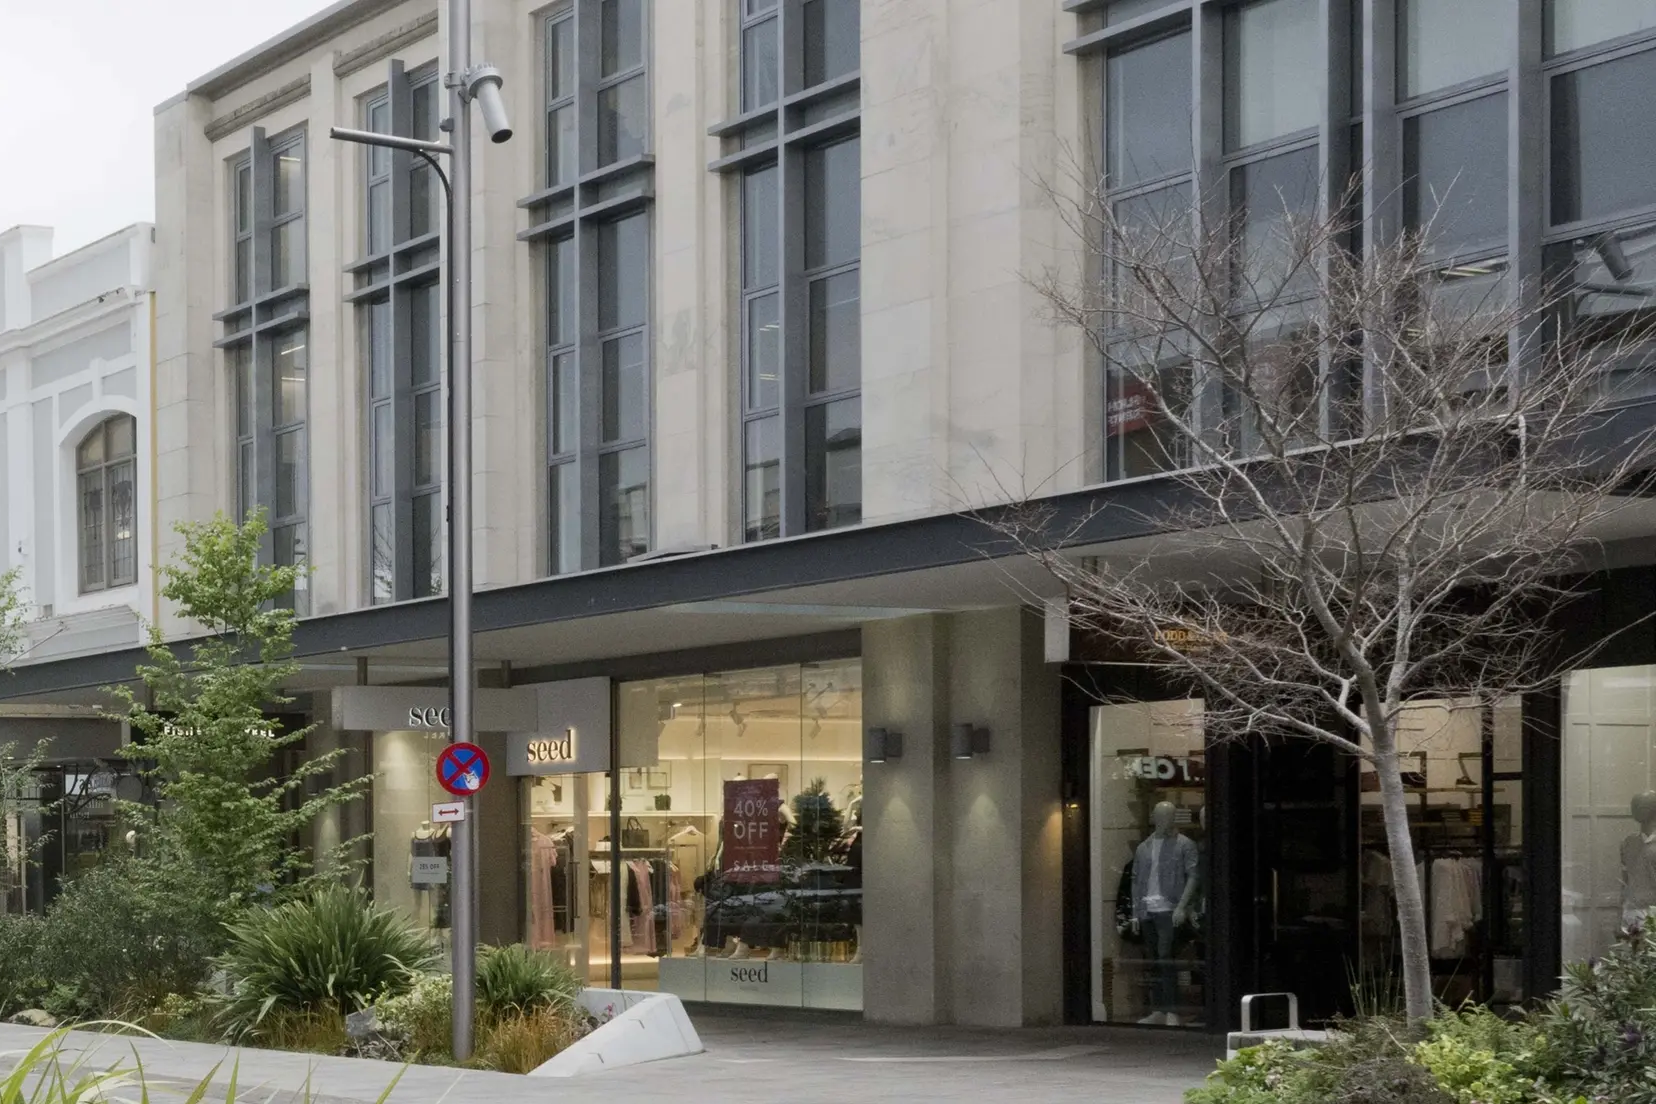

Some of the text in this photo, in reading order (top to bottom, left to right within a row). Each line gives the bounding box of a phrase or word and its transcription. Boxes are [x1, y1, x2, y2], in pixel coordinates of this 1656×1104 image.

[527, 728, 573, 762] seed
[733, 799, 769, 818] 40%
[733, 821, 769, 840] OFF
[733, 860, 769, 872] SALE
[730, 961, 769, 983] seed
